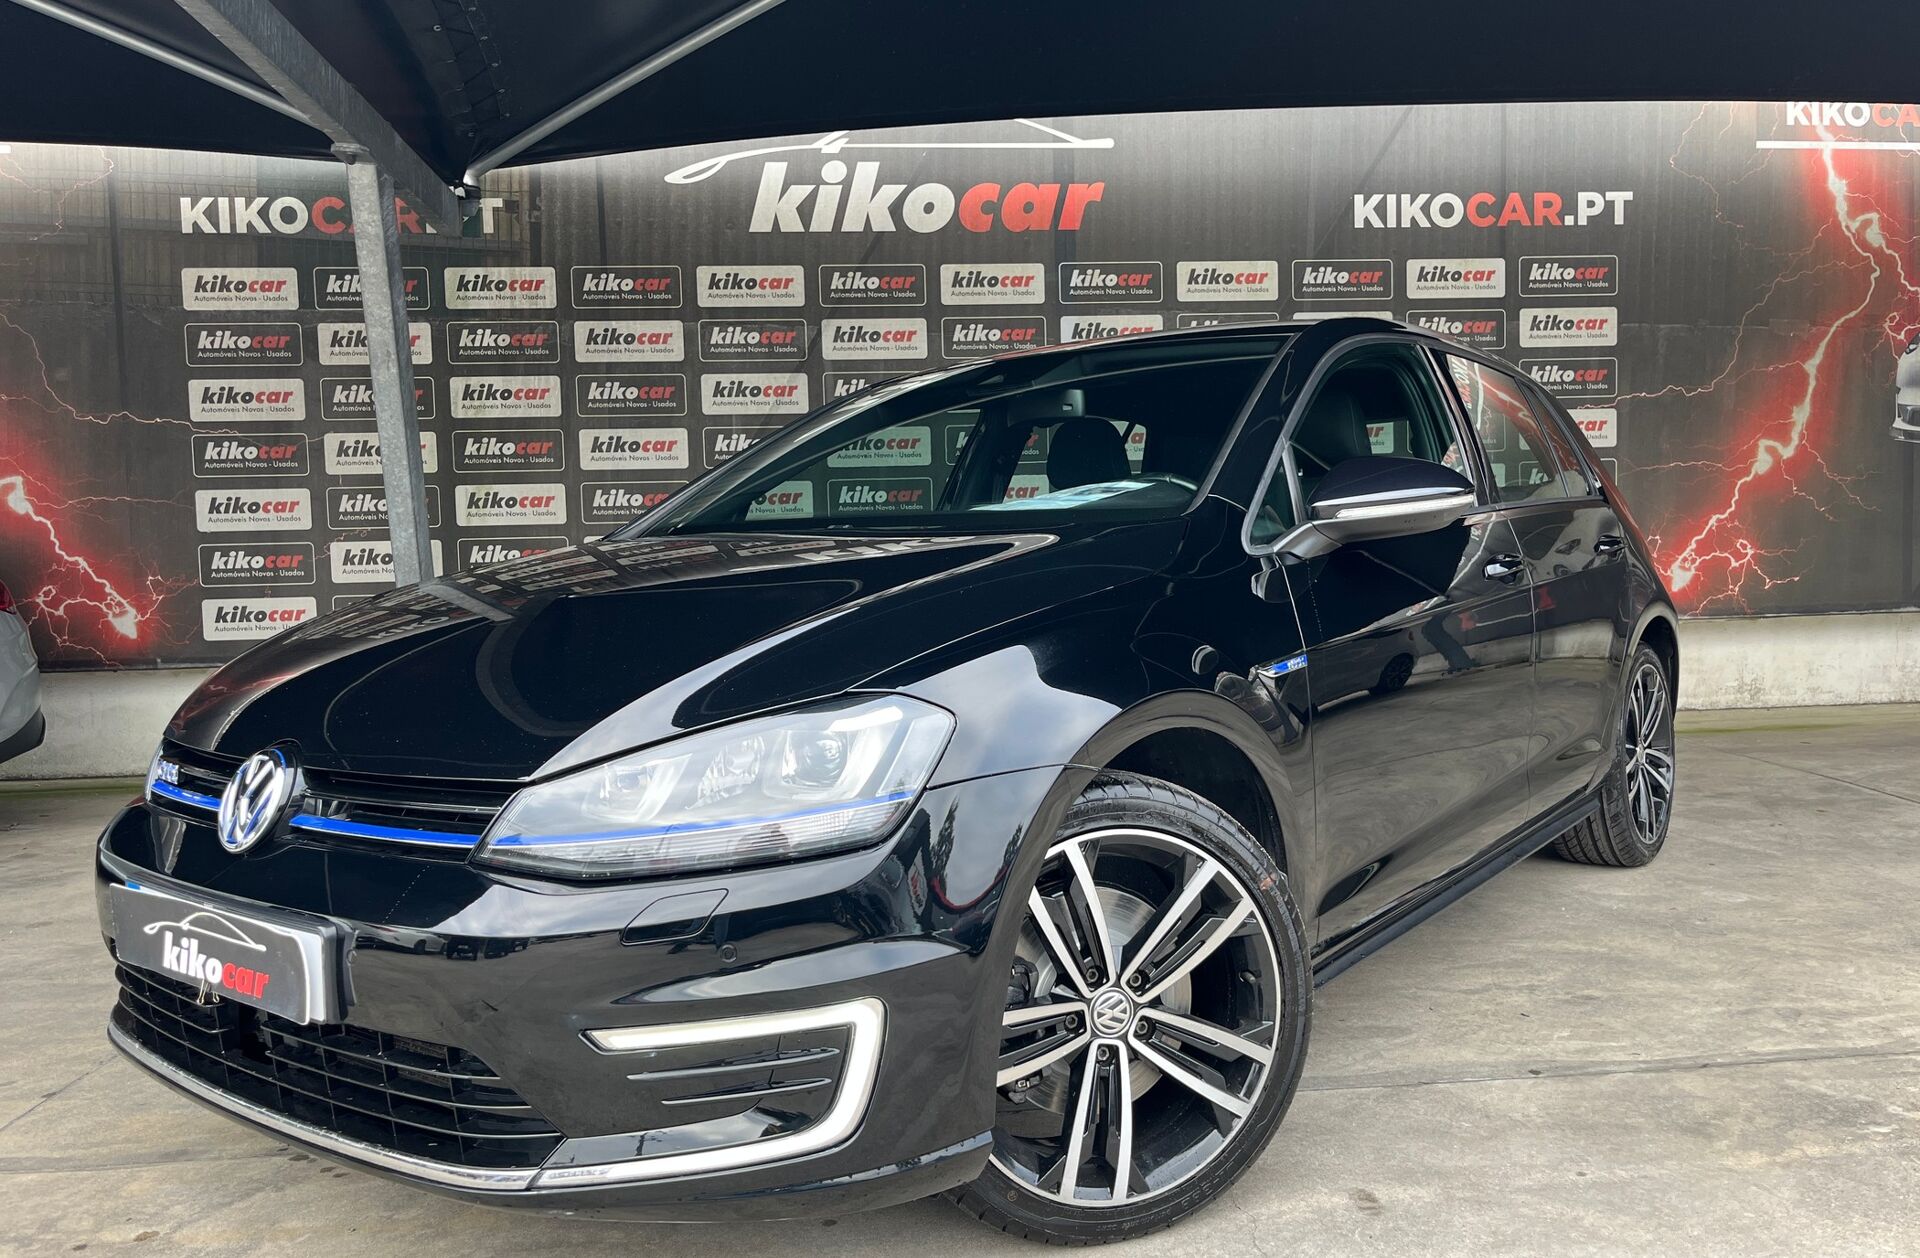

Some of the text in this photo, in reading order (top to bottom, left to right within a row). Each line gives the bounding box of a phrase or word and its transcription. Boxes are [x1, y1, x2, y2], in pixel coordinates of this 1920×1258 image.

[748, 160, 1106, 233] kikocar
[1354, 191, 1634, 228] KIKOCAR.PT
[952, 271, 1034, 288] kikocar
[1070, 269, 1152, 286] kikocar
[1187, 268, 1268, 285] kikocar
[1303, 267, 1382, 284] kikocar
[1417, 266, 1495, 282] kikocar
[1529, 263, 1607, 280] kikocar
[194, 275, 287, 292] kikocar
[456, 274, 545, 292] kikocar
[583, 273, 670, 291] kikocar
[708, 273, 794, 290] kikocar
[830, 272, 915, 289] kikocar
[1530, 315, 1608, 331] kikocar
[198, 331, 290, 348] kikocar
[459, 329, 548, 346] kikocar
[586, 328, 673, 345] kikocar
[710, 326, 796, 344] kikocar
[833, 326, 917, 343] kikocar
[953, 324, 1036, 341] kikocar
[201, 386, 294, 404] kikocar
[462, 383, 551, 401] kikocar
[588, 382, 675, 399] kikocar
[712, 381, 798, 398] kikocar
[204, 441, 297, 459] kikocar
[464, 437, 553, 455] kikocar
[591, 436, 678, 453] kikocar
[467, 491, 556, 509] kikocar
[839, 486, 923, 503] kikocar
[208, 496, 300, 514] kikocar
[211, 551, 303, 569] kikocar
[214, 606, 307, 623] kikocar
[162, 930, 270, 998] kikocar
